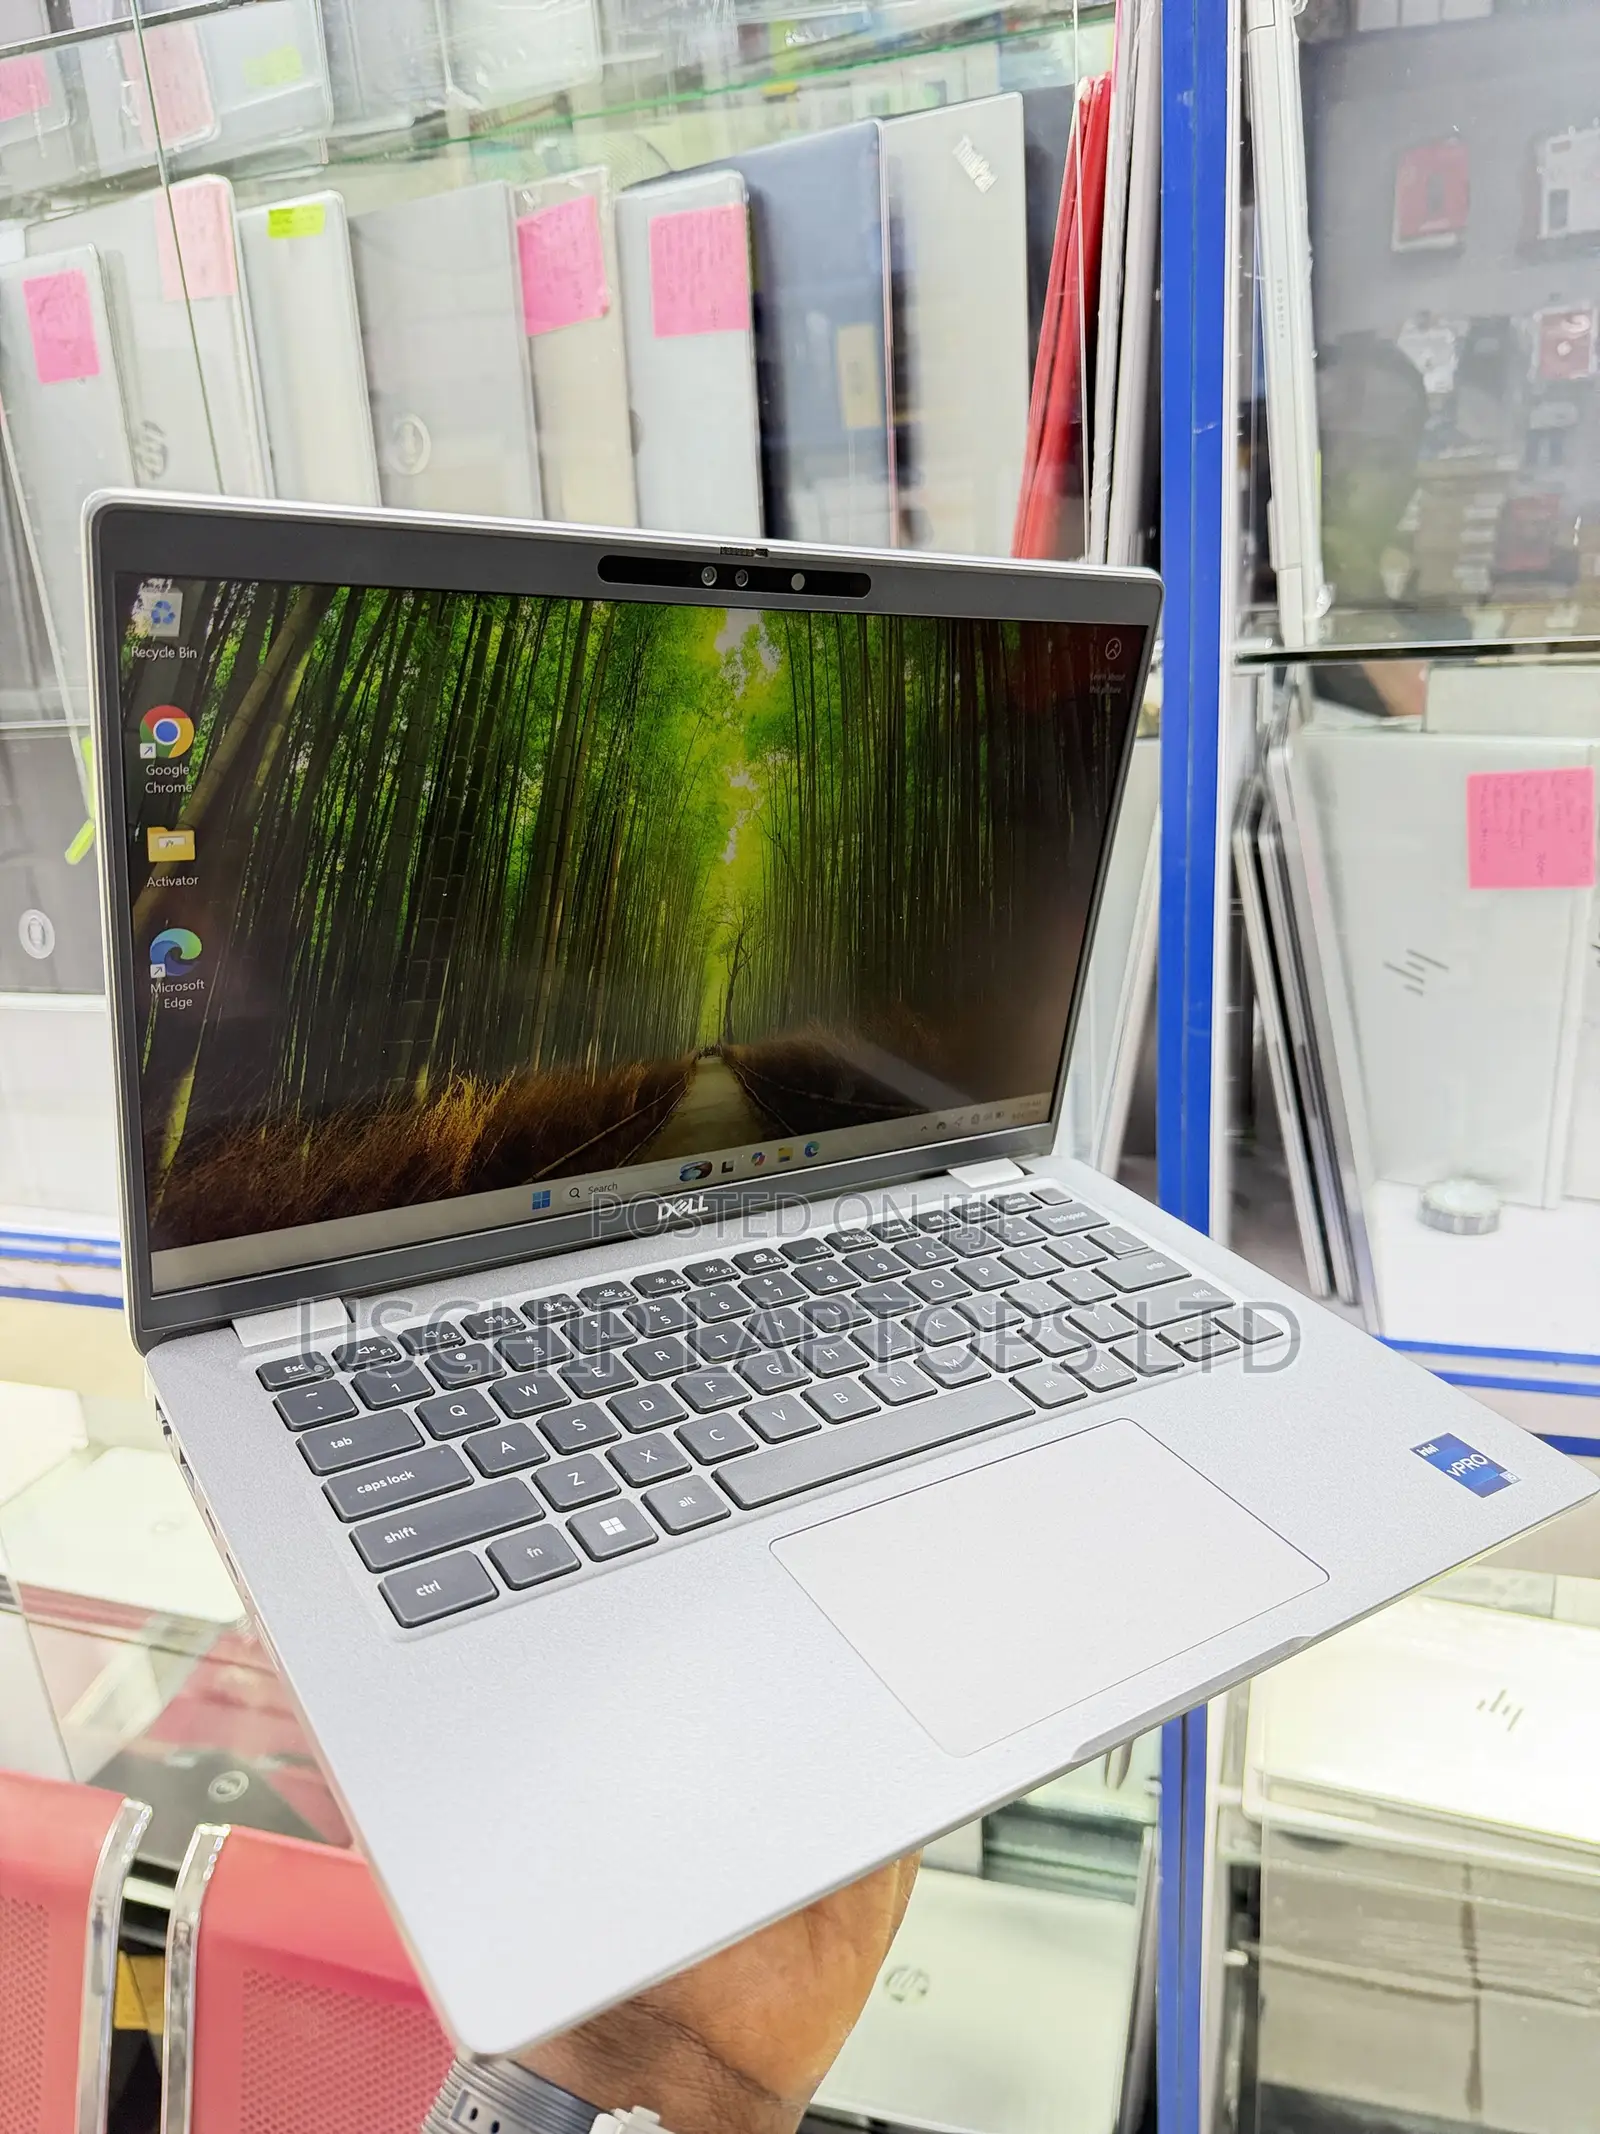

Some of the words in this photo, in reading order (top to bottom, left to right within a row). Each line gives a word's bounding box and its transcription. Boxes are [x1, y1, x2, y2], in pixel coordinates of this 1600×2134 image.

[131, 646, 176, 661] Recycle
[179, 646, 197, 659] Bin
[146, 764, 190, 778] Google
[145, 782, 193, 794] Chrome
[147, 876, 199, 888] Activator
[151, 980, 205, 994] Microsoft
[164, 998, 193, 1010] Edge
[588, 1181, 618, 1195] Search
[657, 1195, 709, 1221] DELL
[876, 1262, 888, 1271] 9
[978, 1266, 990, 1277] P
[670, 1278, 684, 1286] F6
[931, 1279, 945, 1289] O
[774, 1287, 784, 1297] 7
[719, 1301, 730, 1311] 6
[827, 1306, 842, 1316] U
[981, 1306, 997, 1315] L
[504, 1317, 518, 1325] F3
[660, 1315, 671, 1325] 5
[773, 1319, 786, 1331] Y
[931, 1318, 947, 1330] K
[442, 1332, 457, 1340] F2
[601, 1330, 610, 1340] 4
[715, 1333, 729, 1345] T
[380, 1346, 393, 1356] F1
[654, 1350, 671, 1361] R
[823, 1348, 839, 1361] H
[284, 1363, 305, 1375] Esc
[463, 1363, 476, 1374] 2
[766, 1364, 781, 1375] G
[943, 1358, 964, 1370] M
[591, 1366, 606, 1379] E
[704, 1380, 717, 1392] F
[888, 1375, 907, 1387] N
[391, 1383, 401, 1393] 1
[518, 1383, 539, 1398] W
[832, 1391, 849, 1403] B
[450, 1404, 468, 1417] Q
[639, 1399, 655, 1412] D
[771, 1409, 788, 1422] V
[571, 1418, 586, 1431] S
[709, 1429, 725, 1442] C
[330, 1437, 353, 1450] tab
[500, 1441, 516, 1454] A
[640, 1449, 658, 1463] X
[1446, 1453, 1489, 1477] vPRO
[356, 1478, 387, 1494] caps
[387, 1470, 415, 1486] lock
[567, 1471, 585, 1487] Z
[678, 1496, 697, 1508] alt
[384, 1525, 417, 1544] shift
[526, 1545, 543, 1558] fn
[416, 1580, 442, 1597] ctrl
